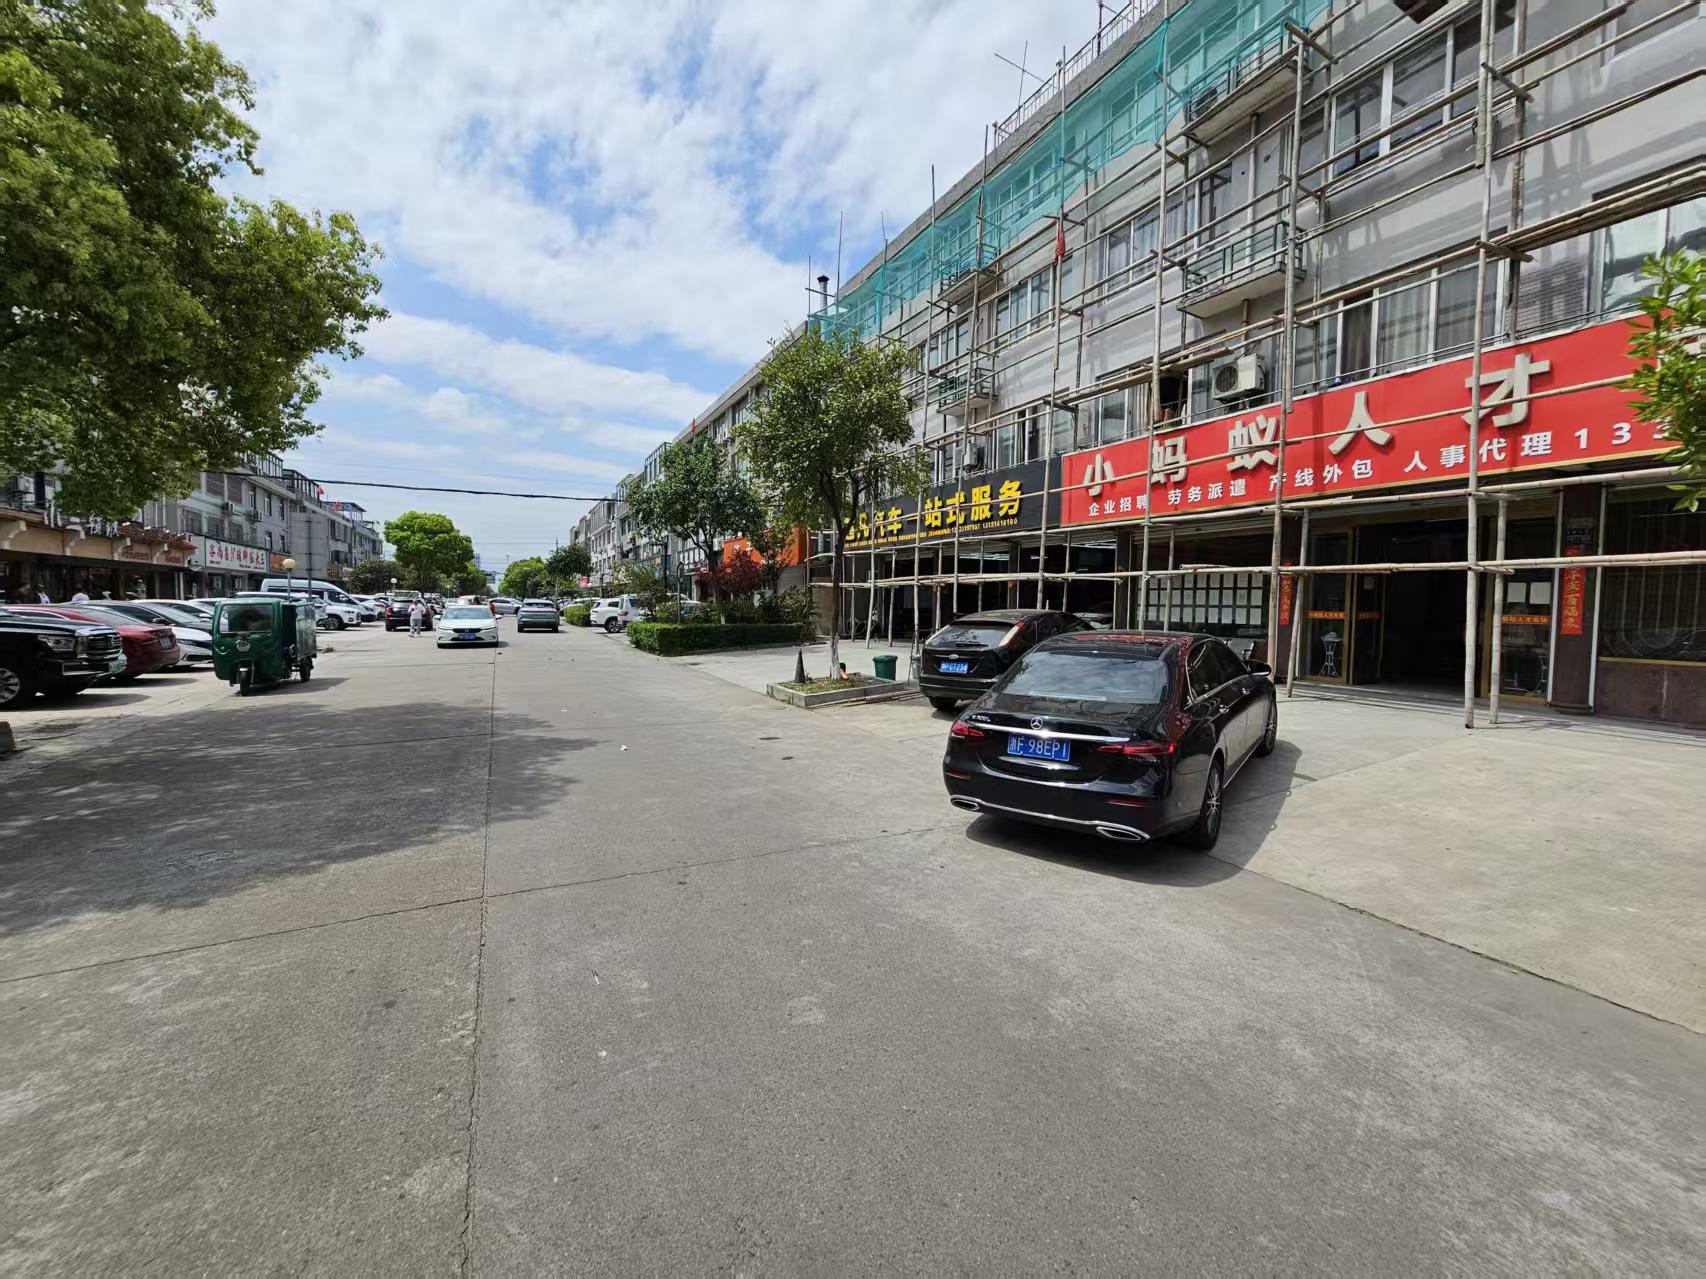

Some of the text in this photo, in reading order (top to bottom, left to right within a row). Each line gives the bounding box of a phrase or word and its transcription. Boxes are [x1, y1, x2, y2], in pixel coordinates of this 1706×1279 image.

[1088, 493, 1149, 517] 企业招聘
[1168, 478, 1247, 504] 劳务派遣
[1269, 459, 1374, 493] 产线外包
[1404, 431, 1552, 474] 人事代理
